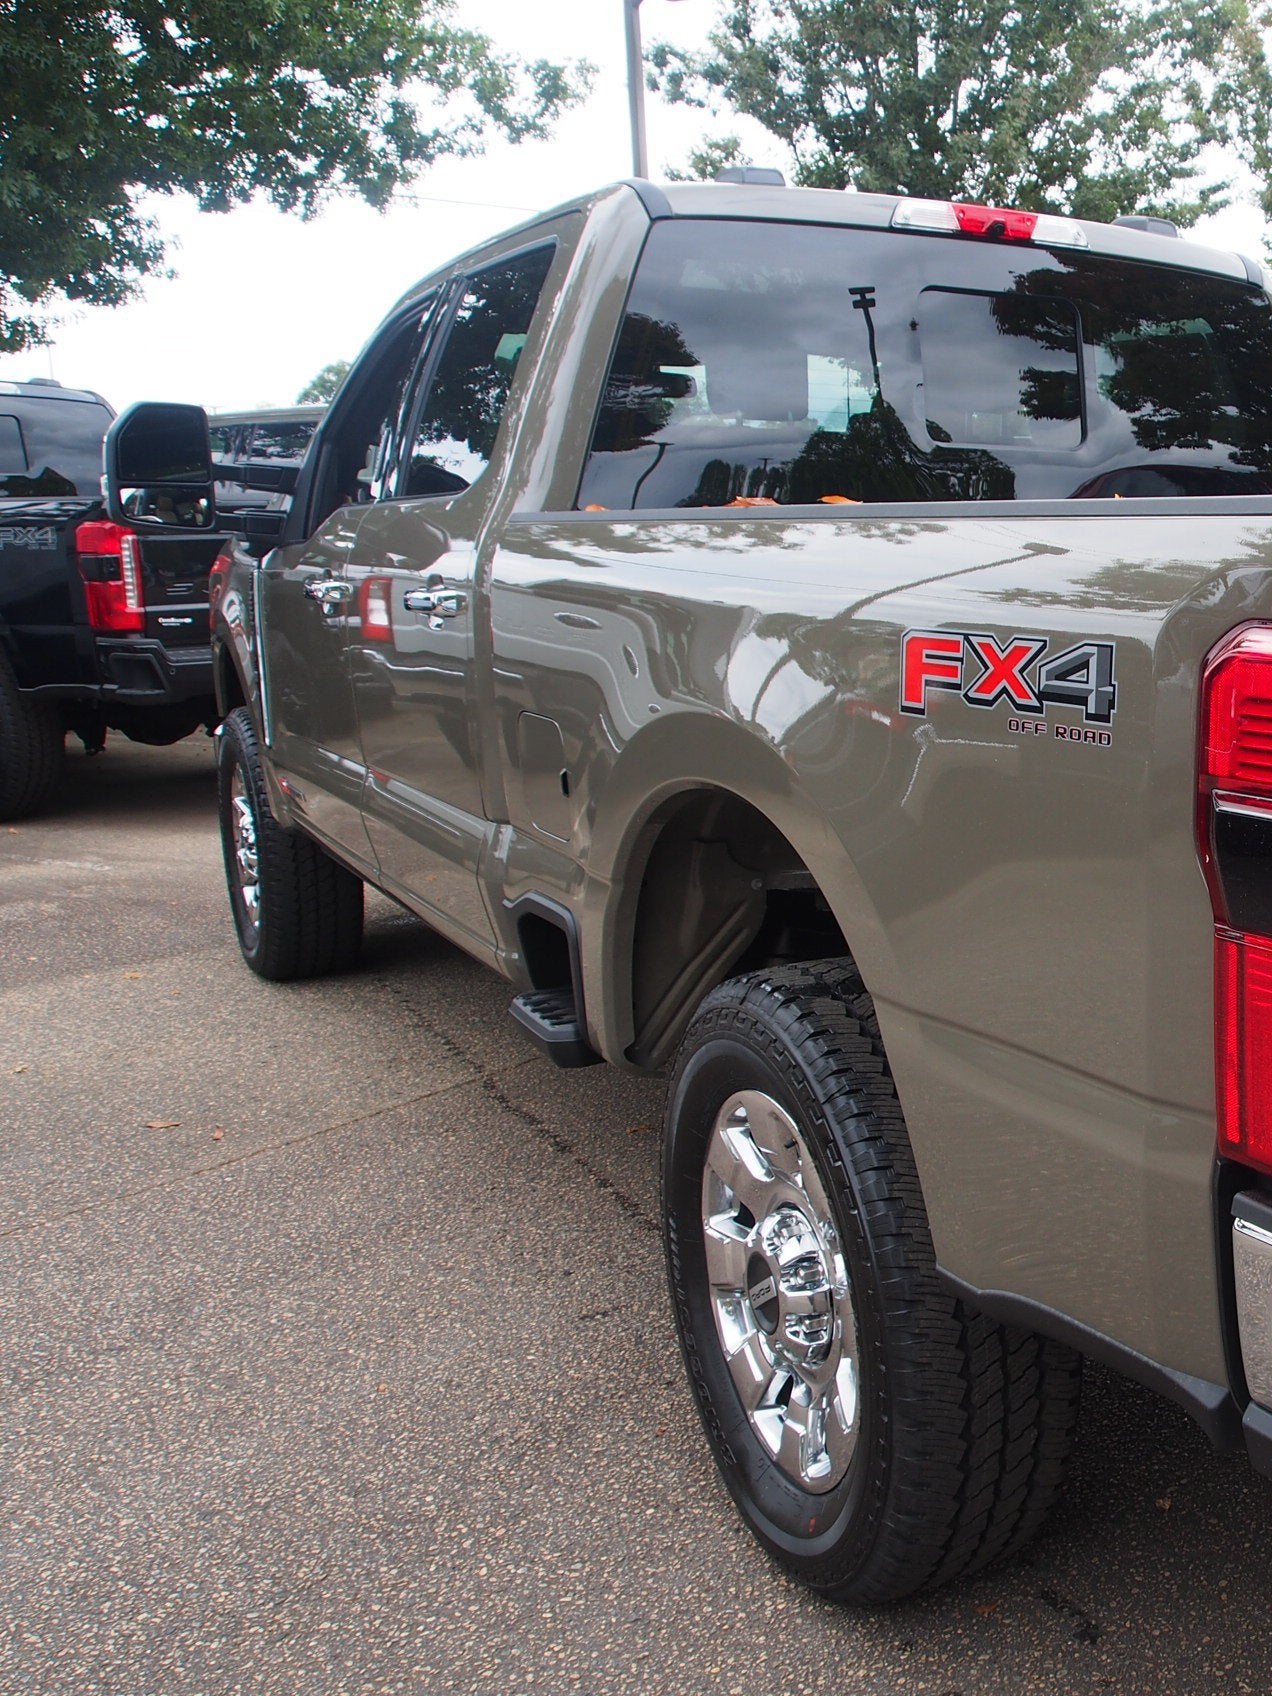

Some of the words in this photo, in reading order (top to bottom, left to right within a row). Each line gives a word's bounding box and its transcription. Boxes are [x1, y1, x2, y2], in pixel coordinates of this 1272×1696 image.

[900, 627, 1117, 726] FX4
[1008, 718, 1047, 735] OFF
[1055, 725, 1112, 746] ROAD
